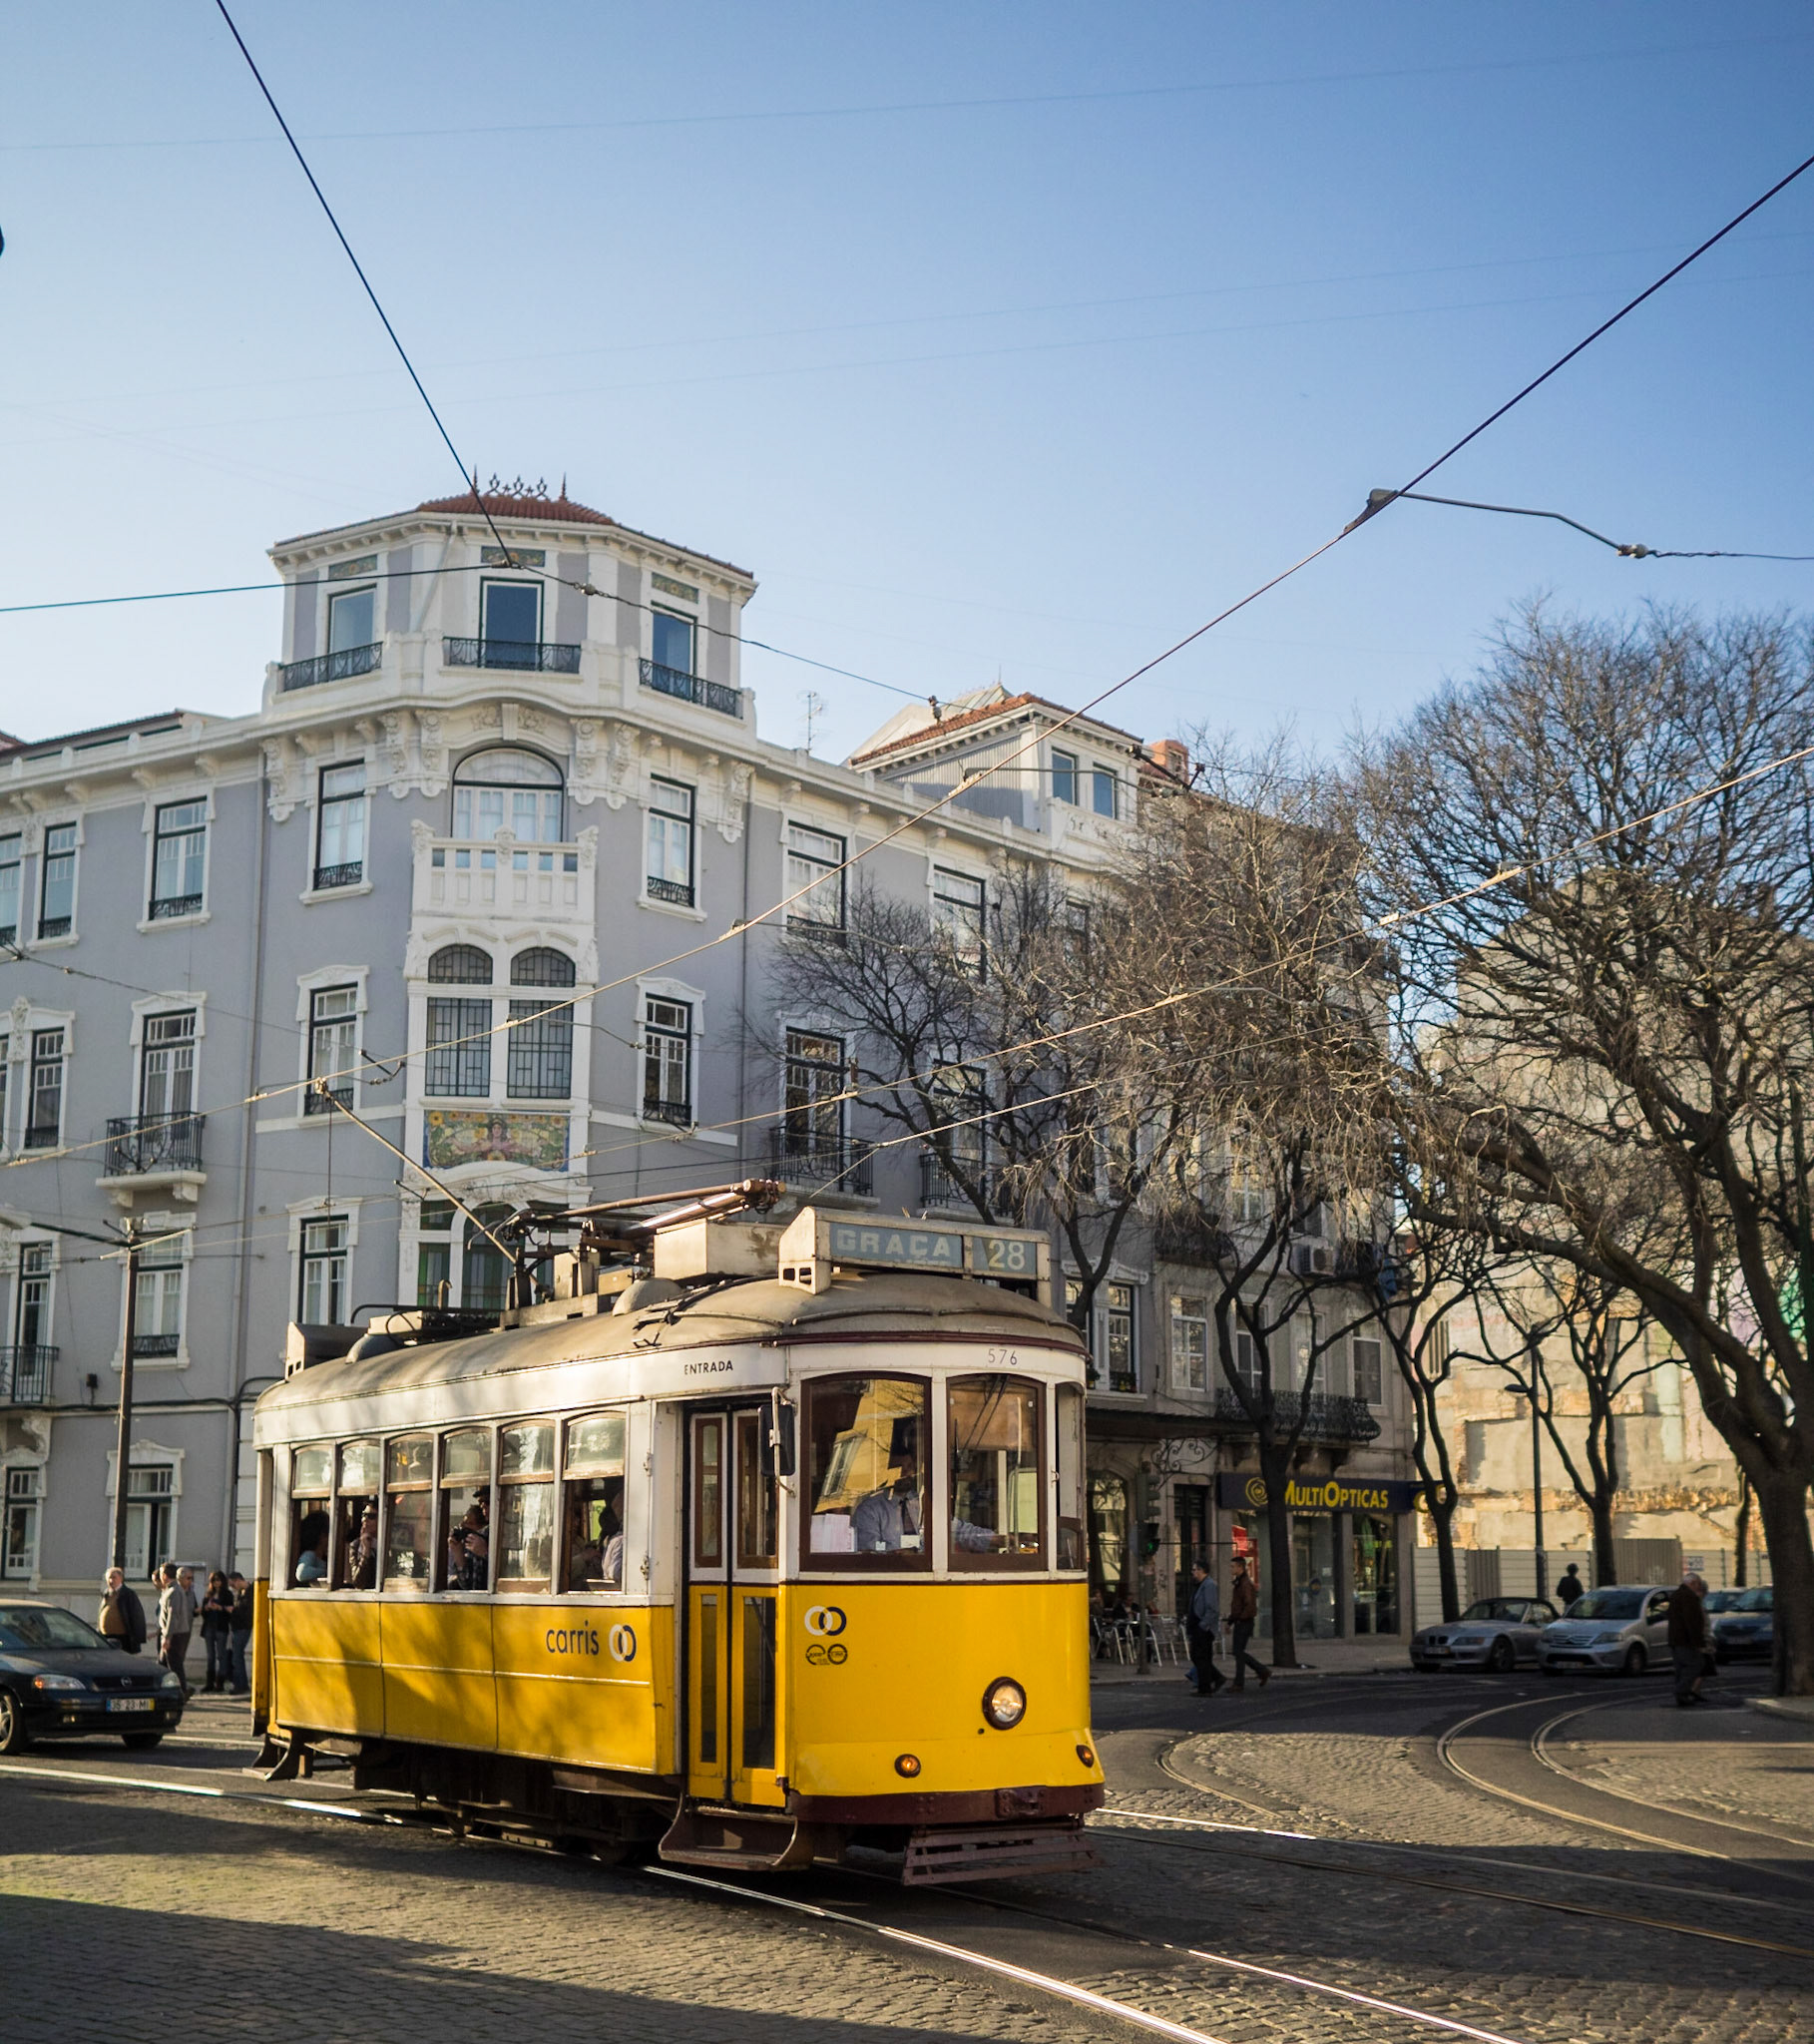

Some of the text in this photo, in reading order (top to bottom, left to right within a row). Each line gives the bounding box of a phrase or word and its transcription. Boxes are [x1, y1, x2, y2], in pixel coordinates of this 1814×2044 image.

[836, 1229, 1026, 1271] GRAÇA 28
[683, 1359, 733, 1375] ENTRADA
[988, 1347, 1018, 1365] 576
[546, 1619, 600, 1656] carris
